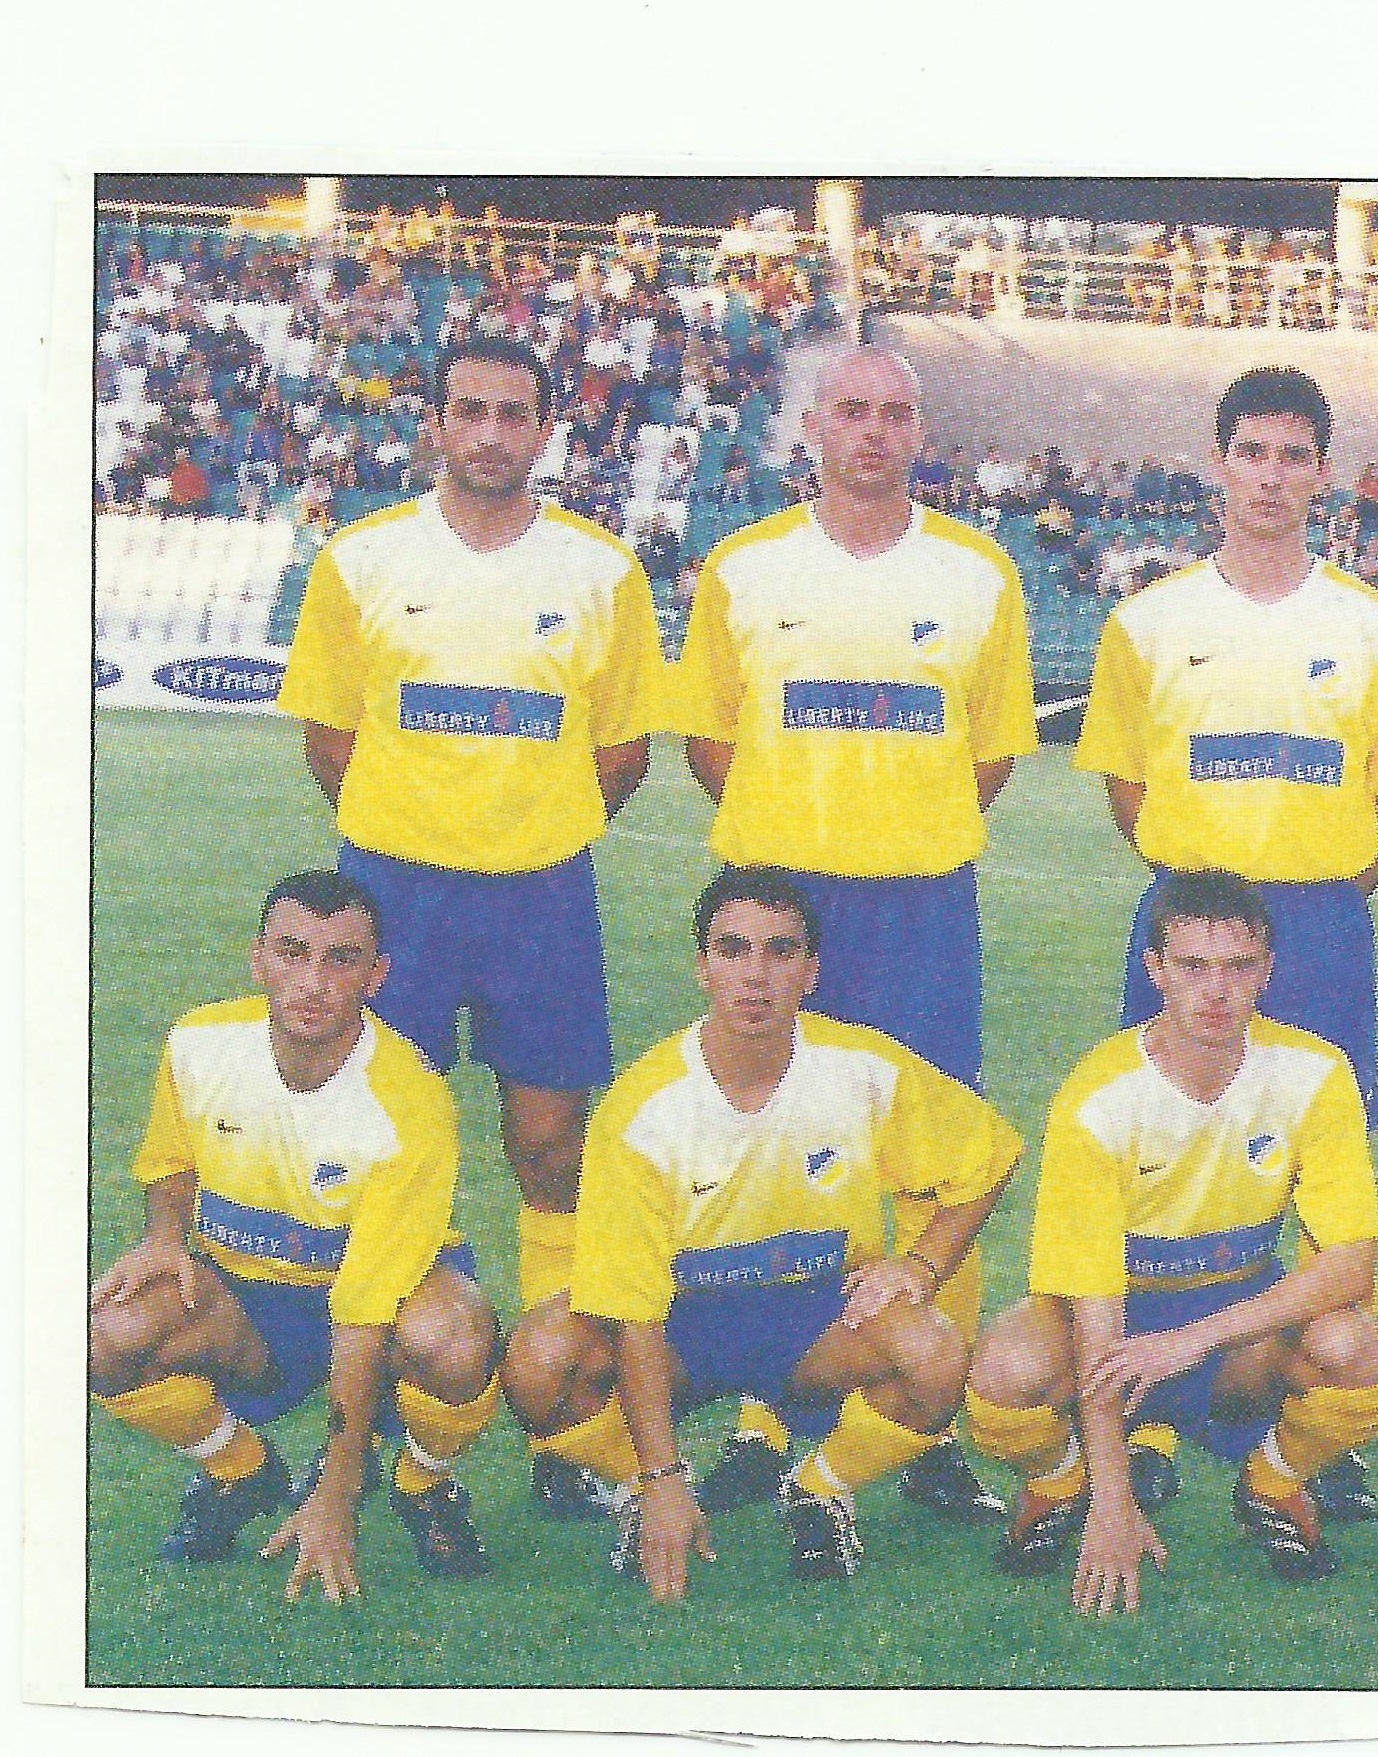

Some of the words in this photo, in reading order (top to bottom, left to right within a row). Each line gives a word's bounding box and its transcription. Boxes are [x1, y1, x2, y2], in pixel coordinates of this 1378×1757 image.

[404, 711, 488, 731] LIBERTY
[786, 707, 869, 726] LIBERTY
[896, 710, 938, 731] LIFE
[1195, 757, 1275, 777] LIBERTY
[1294, 763, 1337, 783] LIFE
